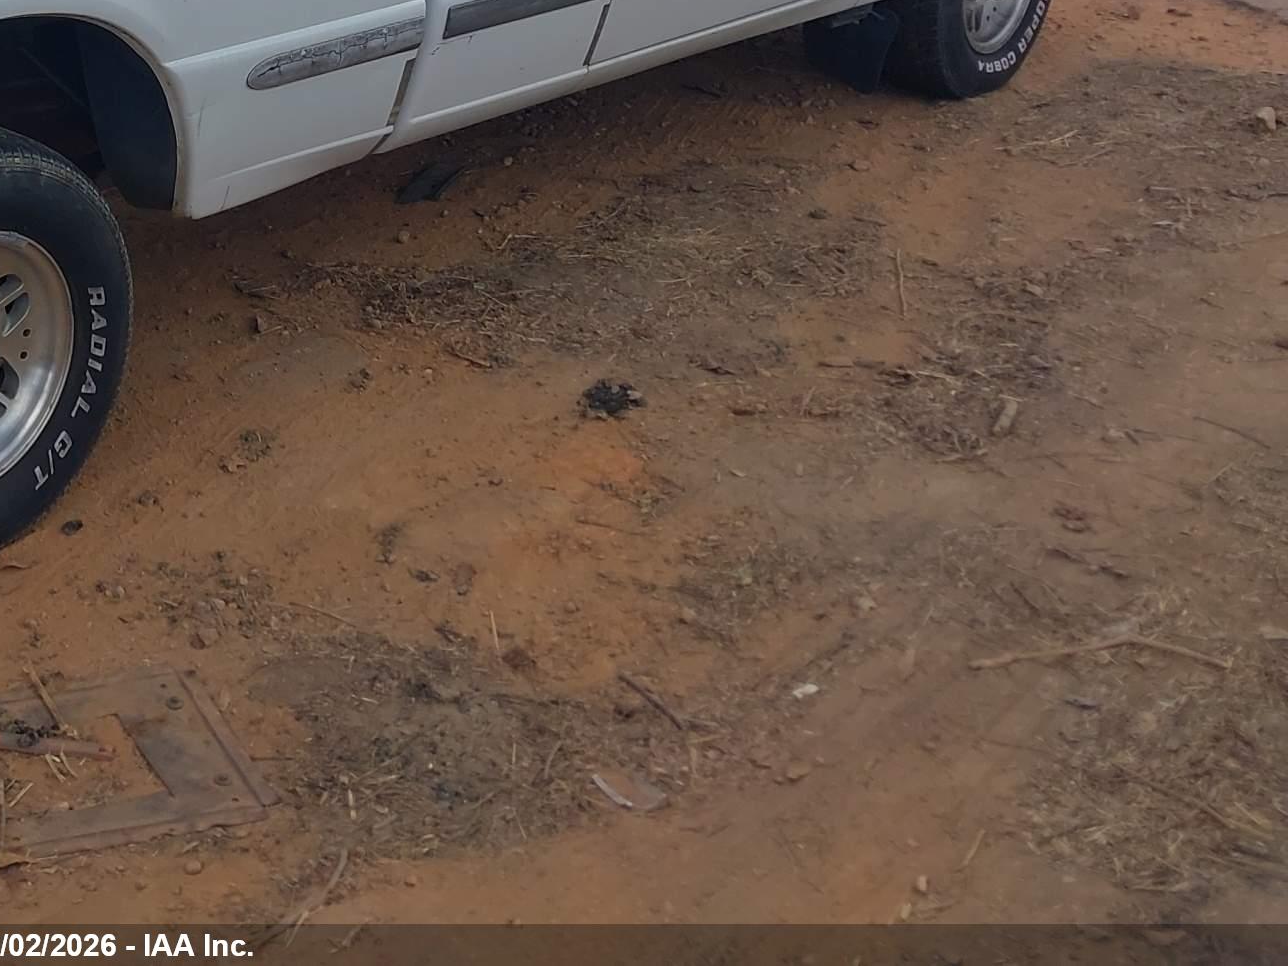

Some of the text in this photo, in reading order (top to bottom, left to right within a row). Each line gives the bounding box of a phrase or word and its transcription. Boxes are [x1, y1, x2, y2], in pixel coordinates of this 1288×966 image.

[977, 53, 1017, 74] COBRA
[33, 286, 108, 491] RADIAL G/T
